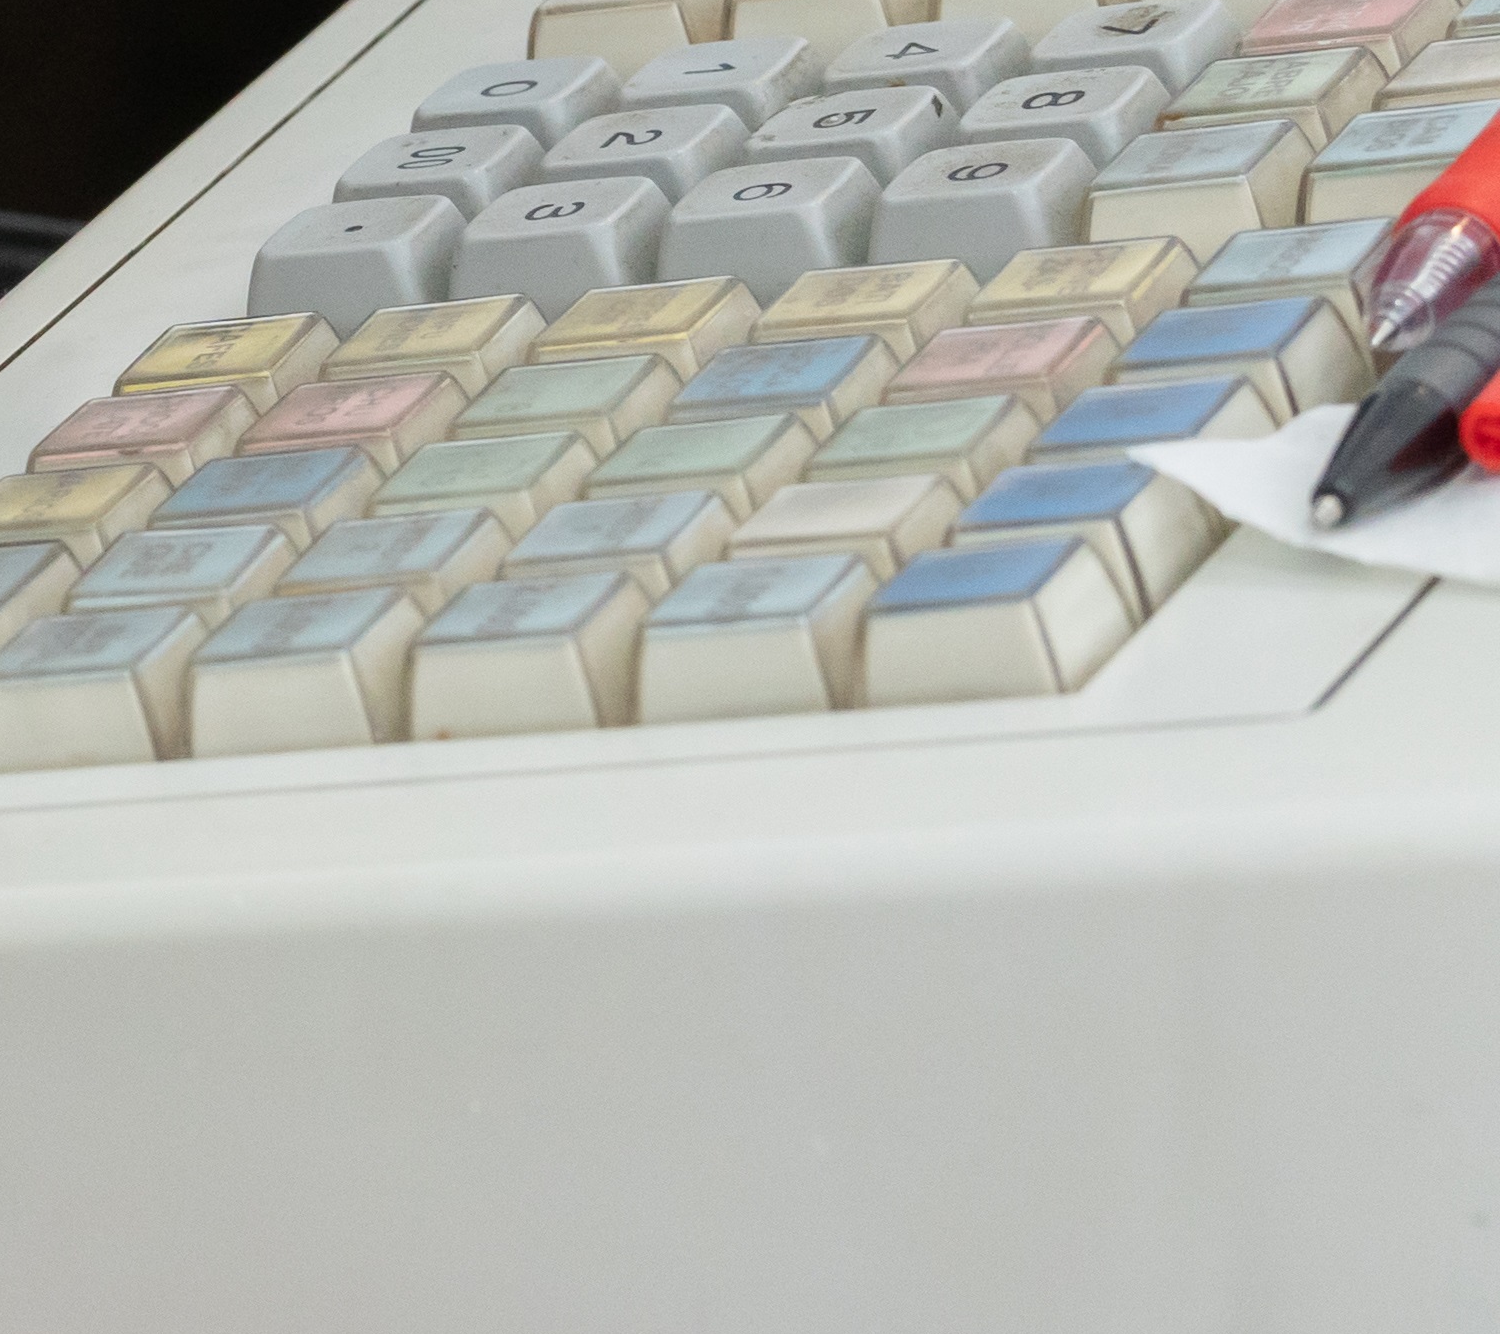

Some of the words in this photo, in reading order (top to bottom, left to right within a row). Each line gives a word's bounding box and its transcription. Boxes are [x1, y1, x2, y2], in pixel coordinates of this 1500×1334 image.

[1100, 16, 1160, 36] 7
[886, 41, 939, 60] 4
[480, 79, 539, 98] 0
[1254, 60, 1311, 100] ABRE
[1021, 89, 1086, 111] 8
[812, 108, 877, 129] 5
[600, 128, 663, 149] 2
[1408, 113, 1457, 147] CAM
[397, 145, 467, 170] 00
[946, 161, 1010, 182] 9
[732, 182, 793, 202] 6
[524, 201, 586, 222] 3
